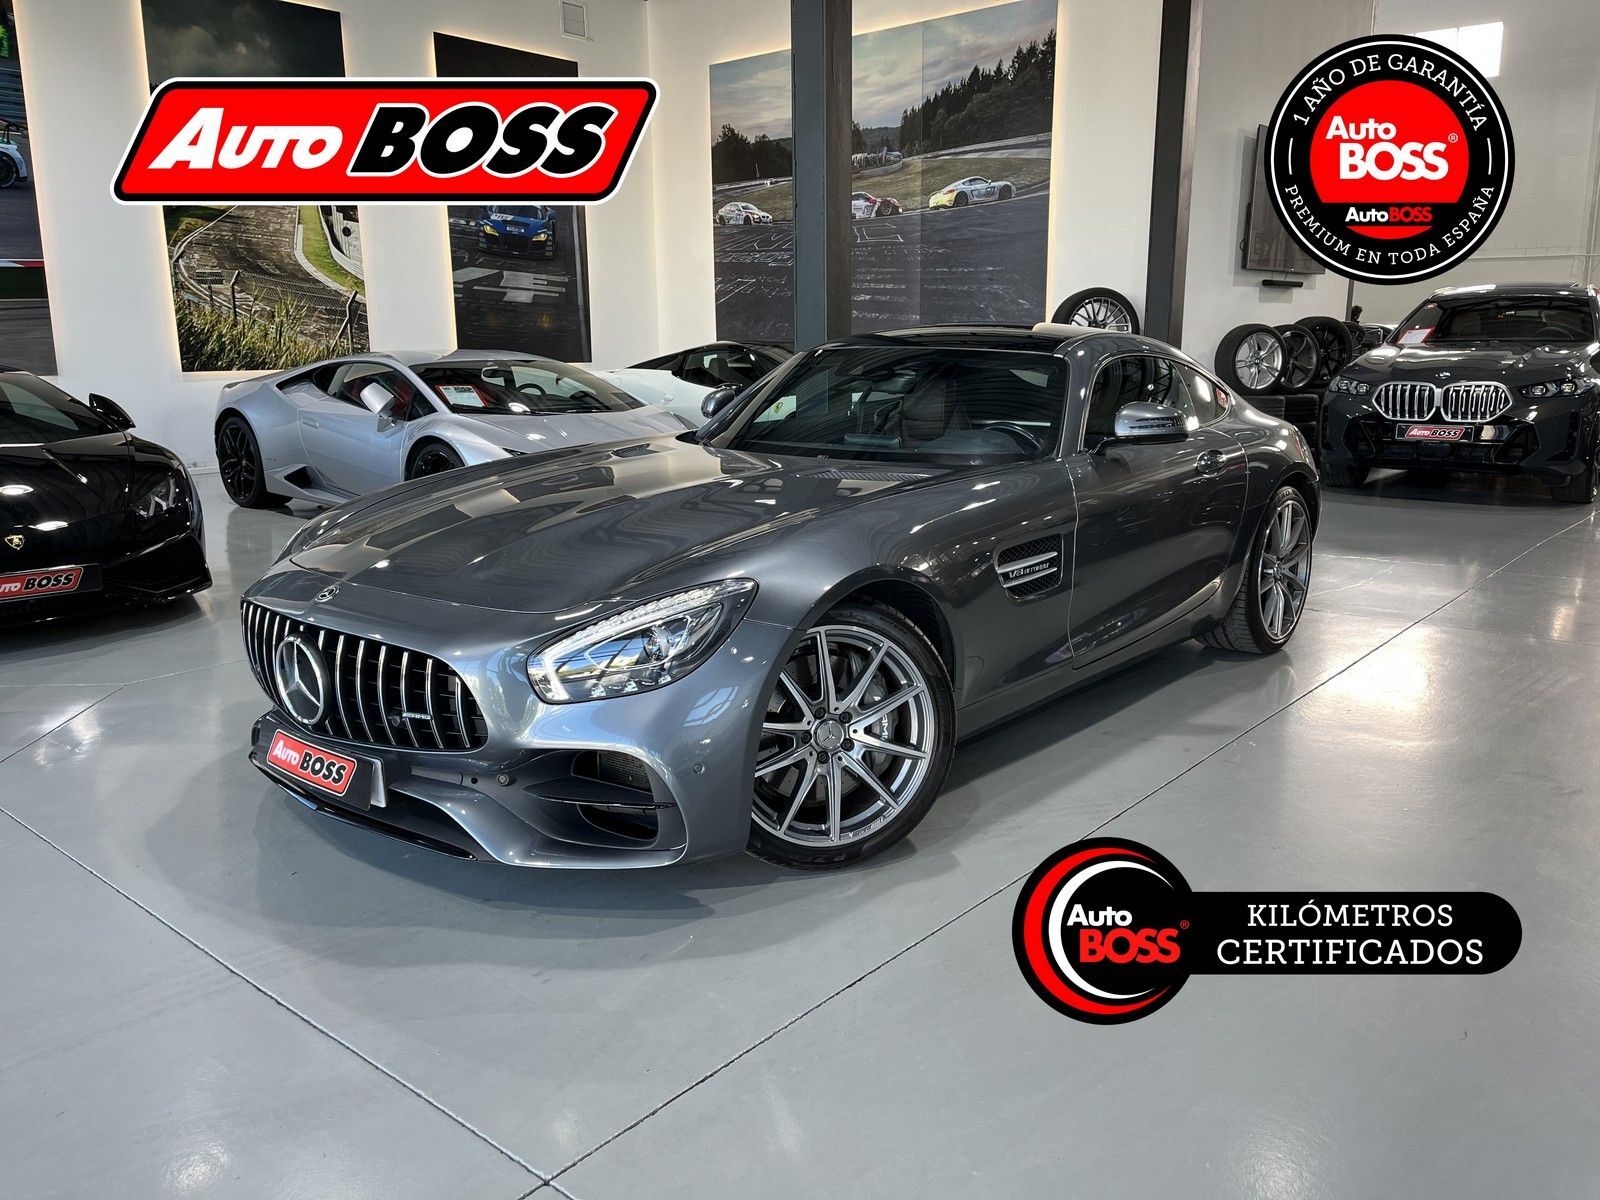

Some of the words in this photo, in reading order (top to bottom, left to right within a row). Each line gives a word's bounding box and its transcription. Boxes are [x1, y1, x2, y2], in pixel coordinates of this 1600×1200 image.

[1430, 428, 1460, 438] BOSS
[22, 572, 75, 592] BOSS
[298, 750, 348, 786] BOSS
